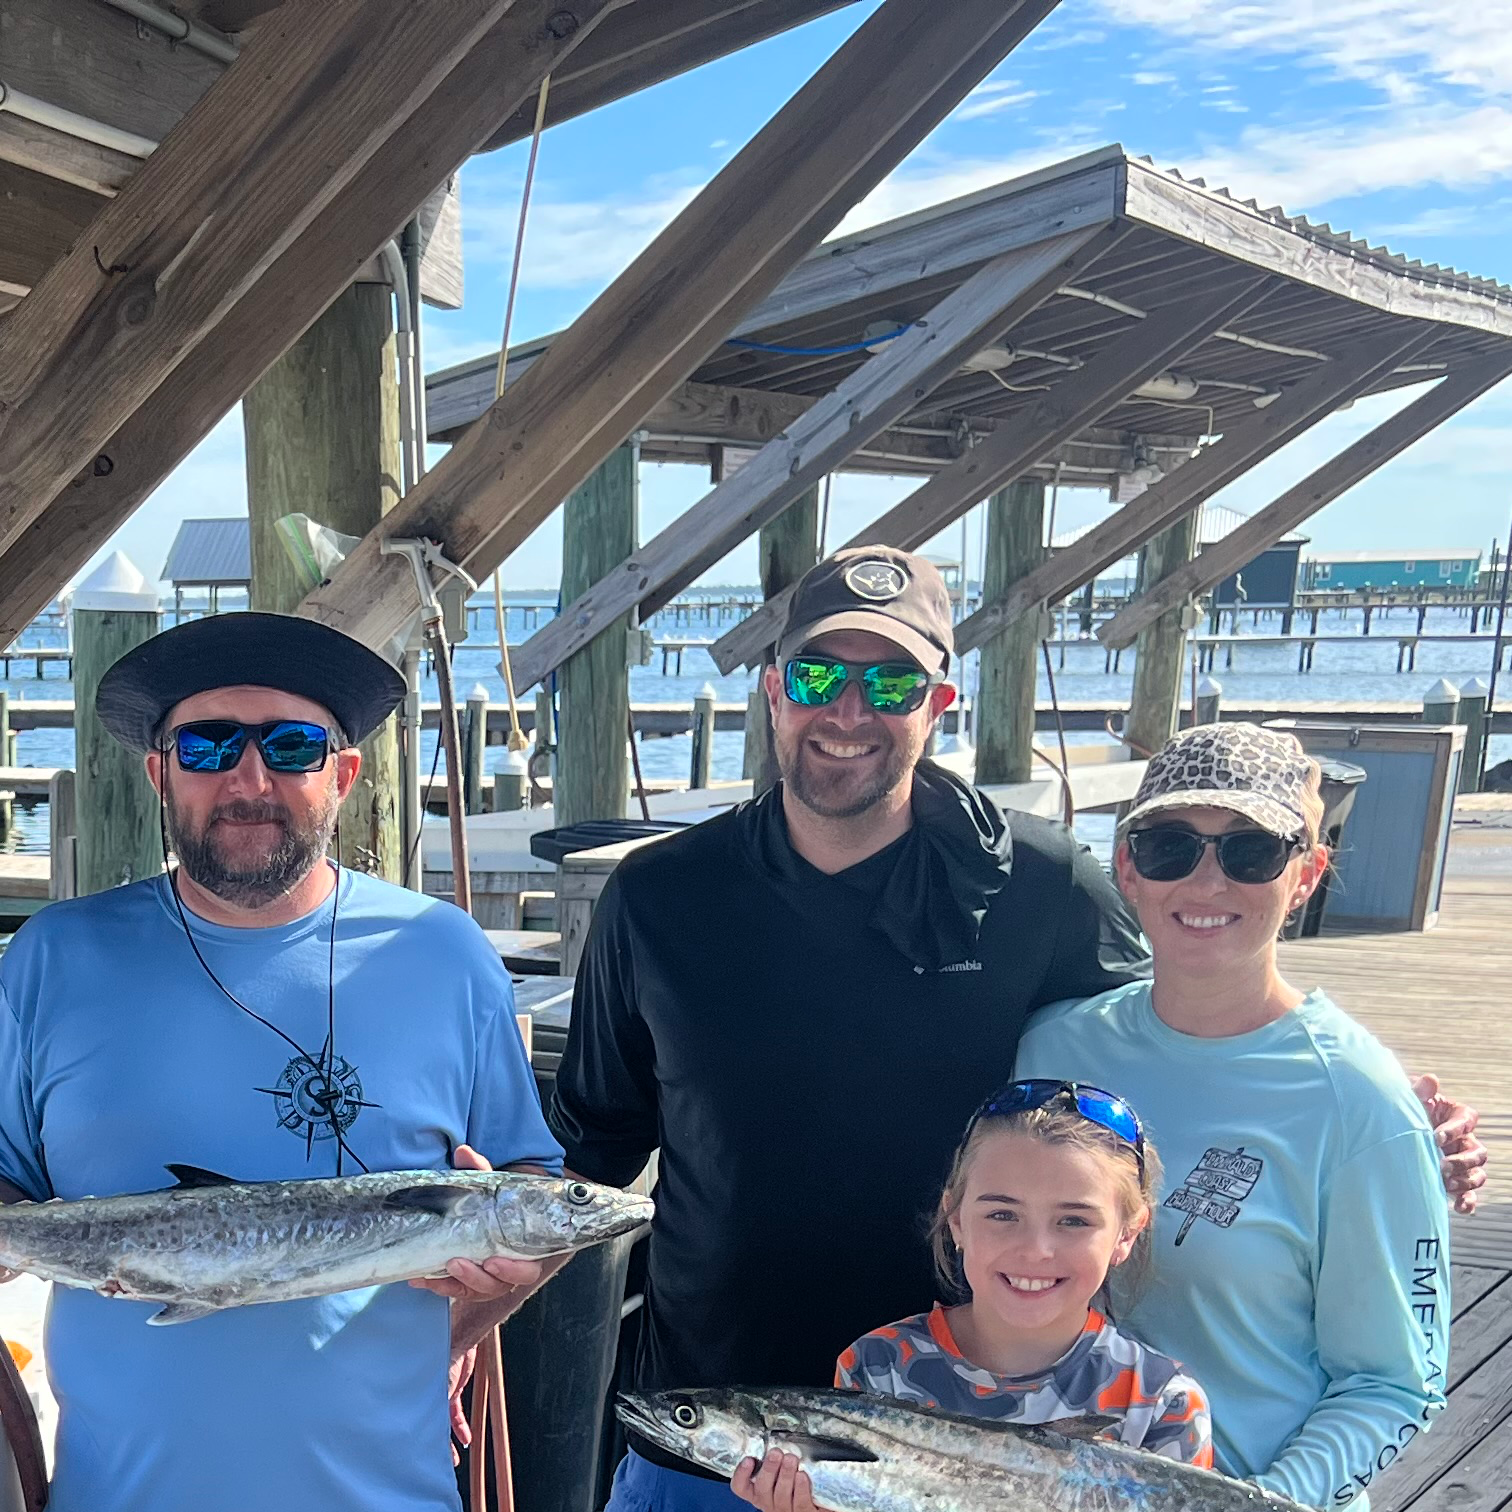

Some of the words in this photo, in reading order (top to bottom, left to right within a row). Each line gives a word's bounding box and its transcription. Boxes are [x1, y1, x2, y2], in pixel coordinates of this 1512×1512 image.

[938, 959, 983, 973] umbia
[1204, 1202, 1234, 1223] HOUR
[1411, 1238, 1444, 1420] EMEA
[1334, 1423, 1418, 1506] COAS
